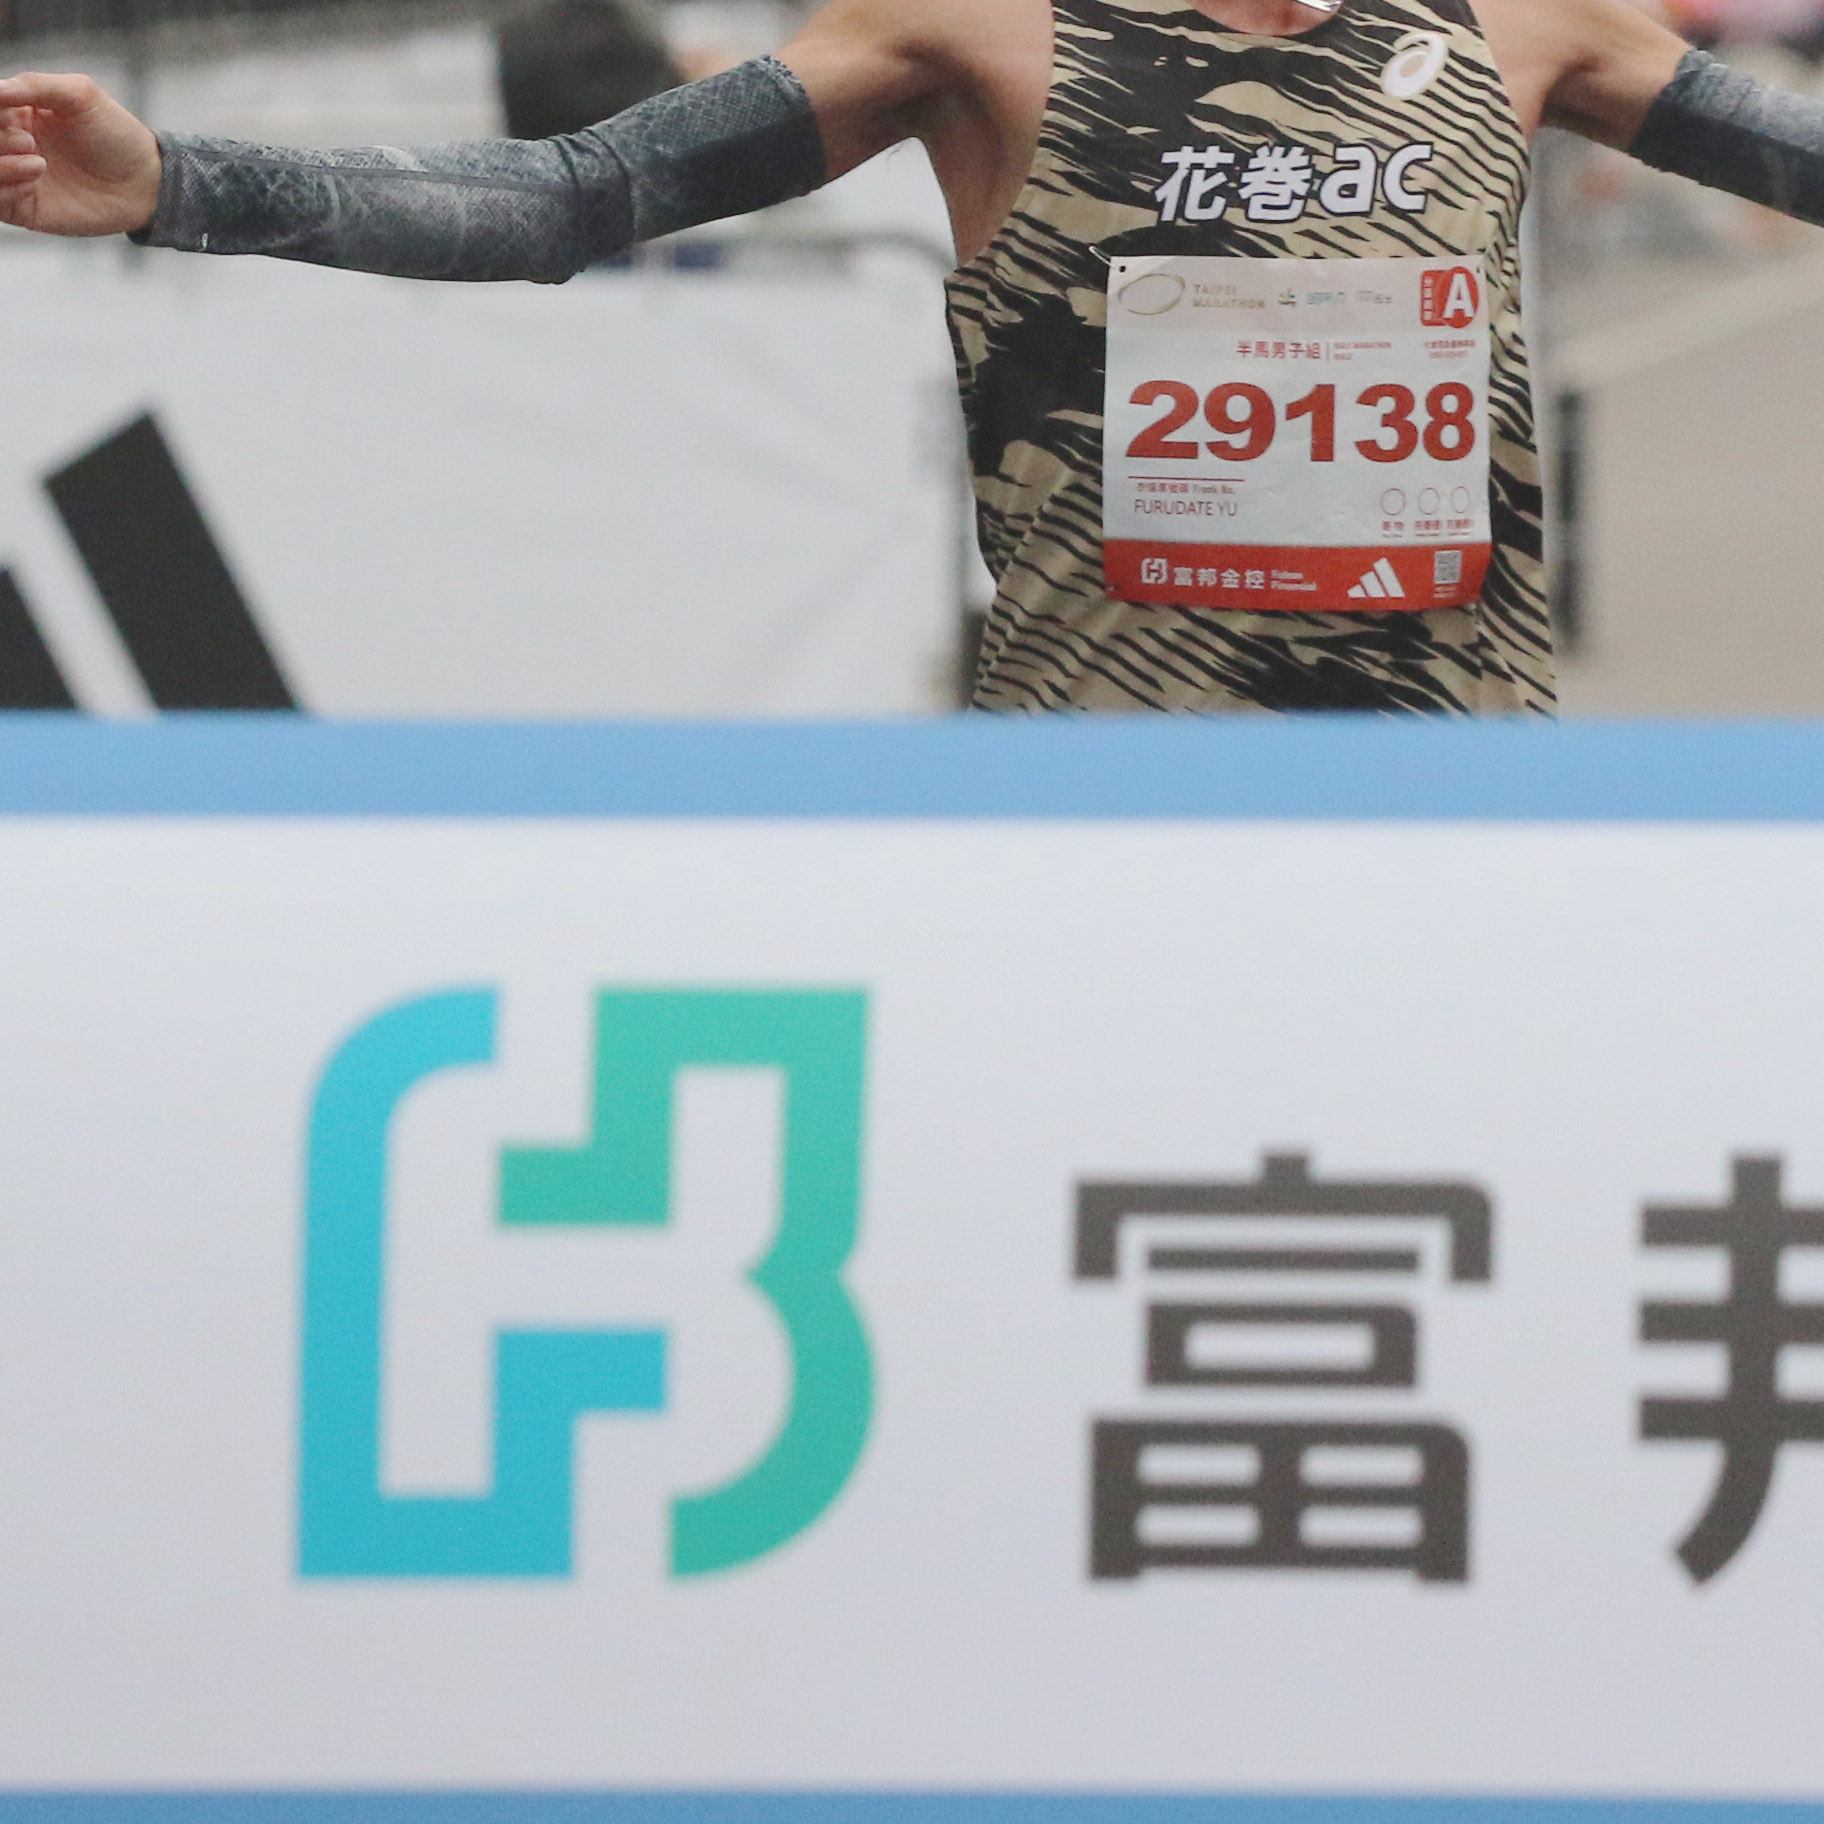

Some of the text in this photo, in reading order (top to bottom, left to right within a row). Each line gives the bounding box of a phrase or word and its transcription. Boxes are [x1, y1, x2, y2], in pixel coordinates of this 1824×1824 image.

[1193, 283, 1237, 295] TAIPEI
[1443, 272, 1475, 318] A
[1192, 297, 1265, 309] MARATHON
[1126, 379, 1475, 463] 29138
[1134, 498, 1238, 516] FURUDATE YU
[1174, 567, 1265, 590] 富邦金控
